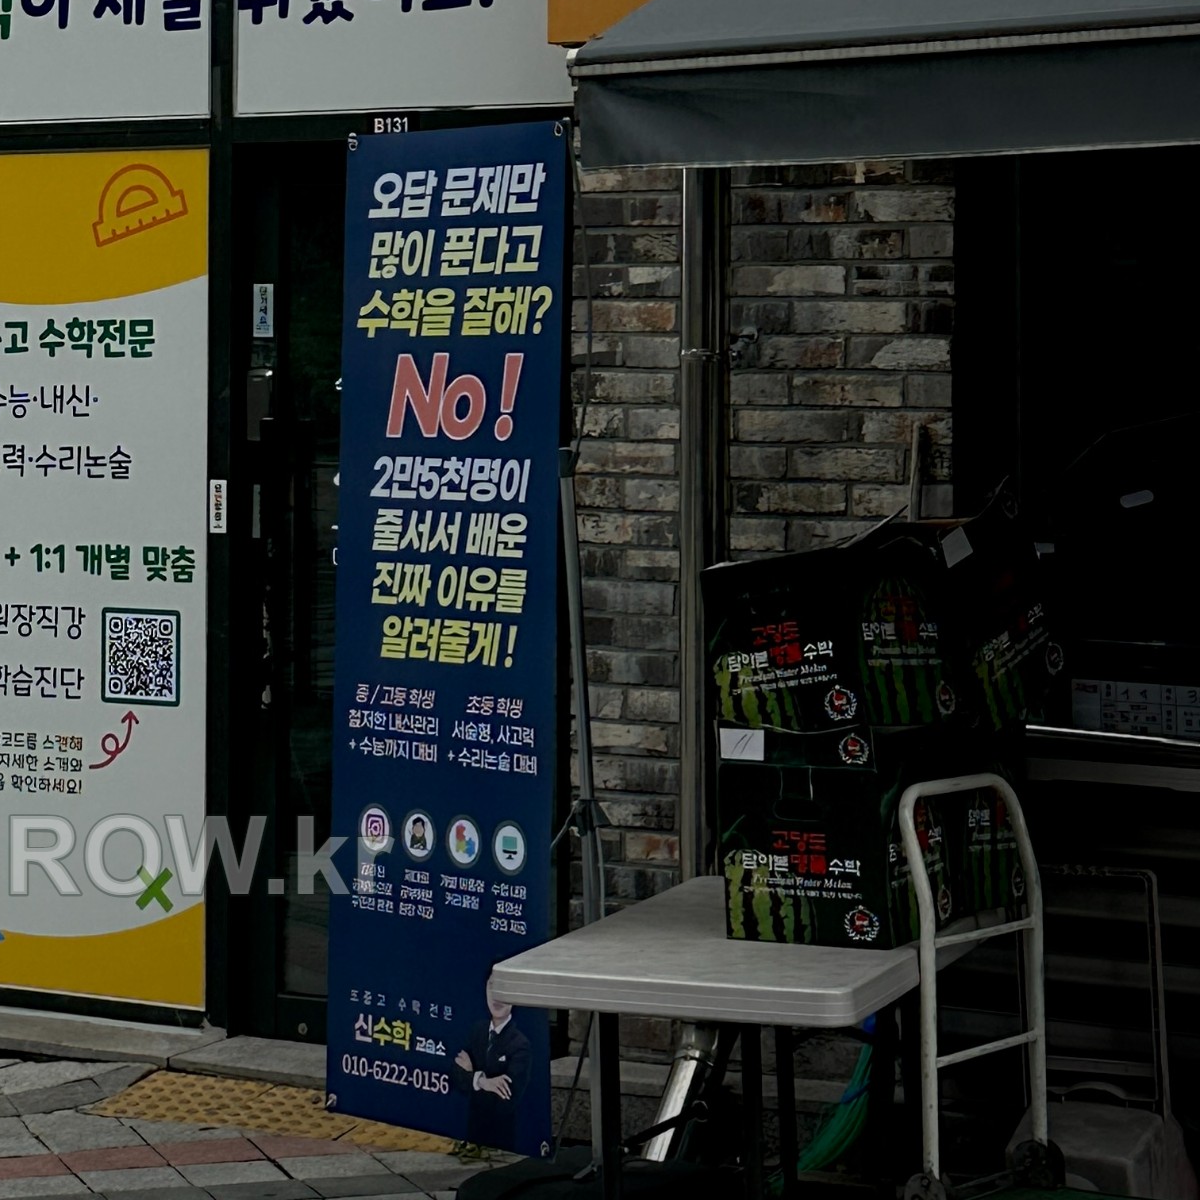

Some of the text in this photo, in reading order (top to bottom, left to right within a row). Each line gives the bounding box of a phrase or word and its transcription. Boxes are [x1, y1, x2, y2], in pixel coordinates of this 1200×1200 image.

[374, 117, 408, 133] B131
[368, 162, 546, 219] 오답 문제만
[368, 225, 543, 279] 많이 푼다고
[357, 286, 553, 338] 수학을 잘해?
[39, 317, 155, 358] 수학전문
[370, 456, 531, 503] 2만5천명이
[371, 508, 528, 558] 줄서서 배운
[5, 553, 21, 567] +
[30, 543, 65, 573] 1:1
[75, 543, 130, 580] 개별
[142, 545, 196, 583] 맞춤
[371, 561, 528, 614] 진짜 이유를
[380, 615, 518, 668] 알려줄게!
[803, 640, 833, 660] 수박
[389, 714, 439, 737] 내신관리
[497, 724, 535, 749] 사고력
[359, 736, 410, 760] 수능까지
[11, 774, 82, 794] 확인하세요!
[829, 858, 861, 877] 수박
[354, 1013, 412, 1051] 신수학
[342, 1054, 450, 1095] 010-6222-0156
